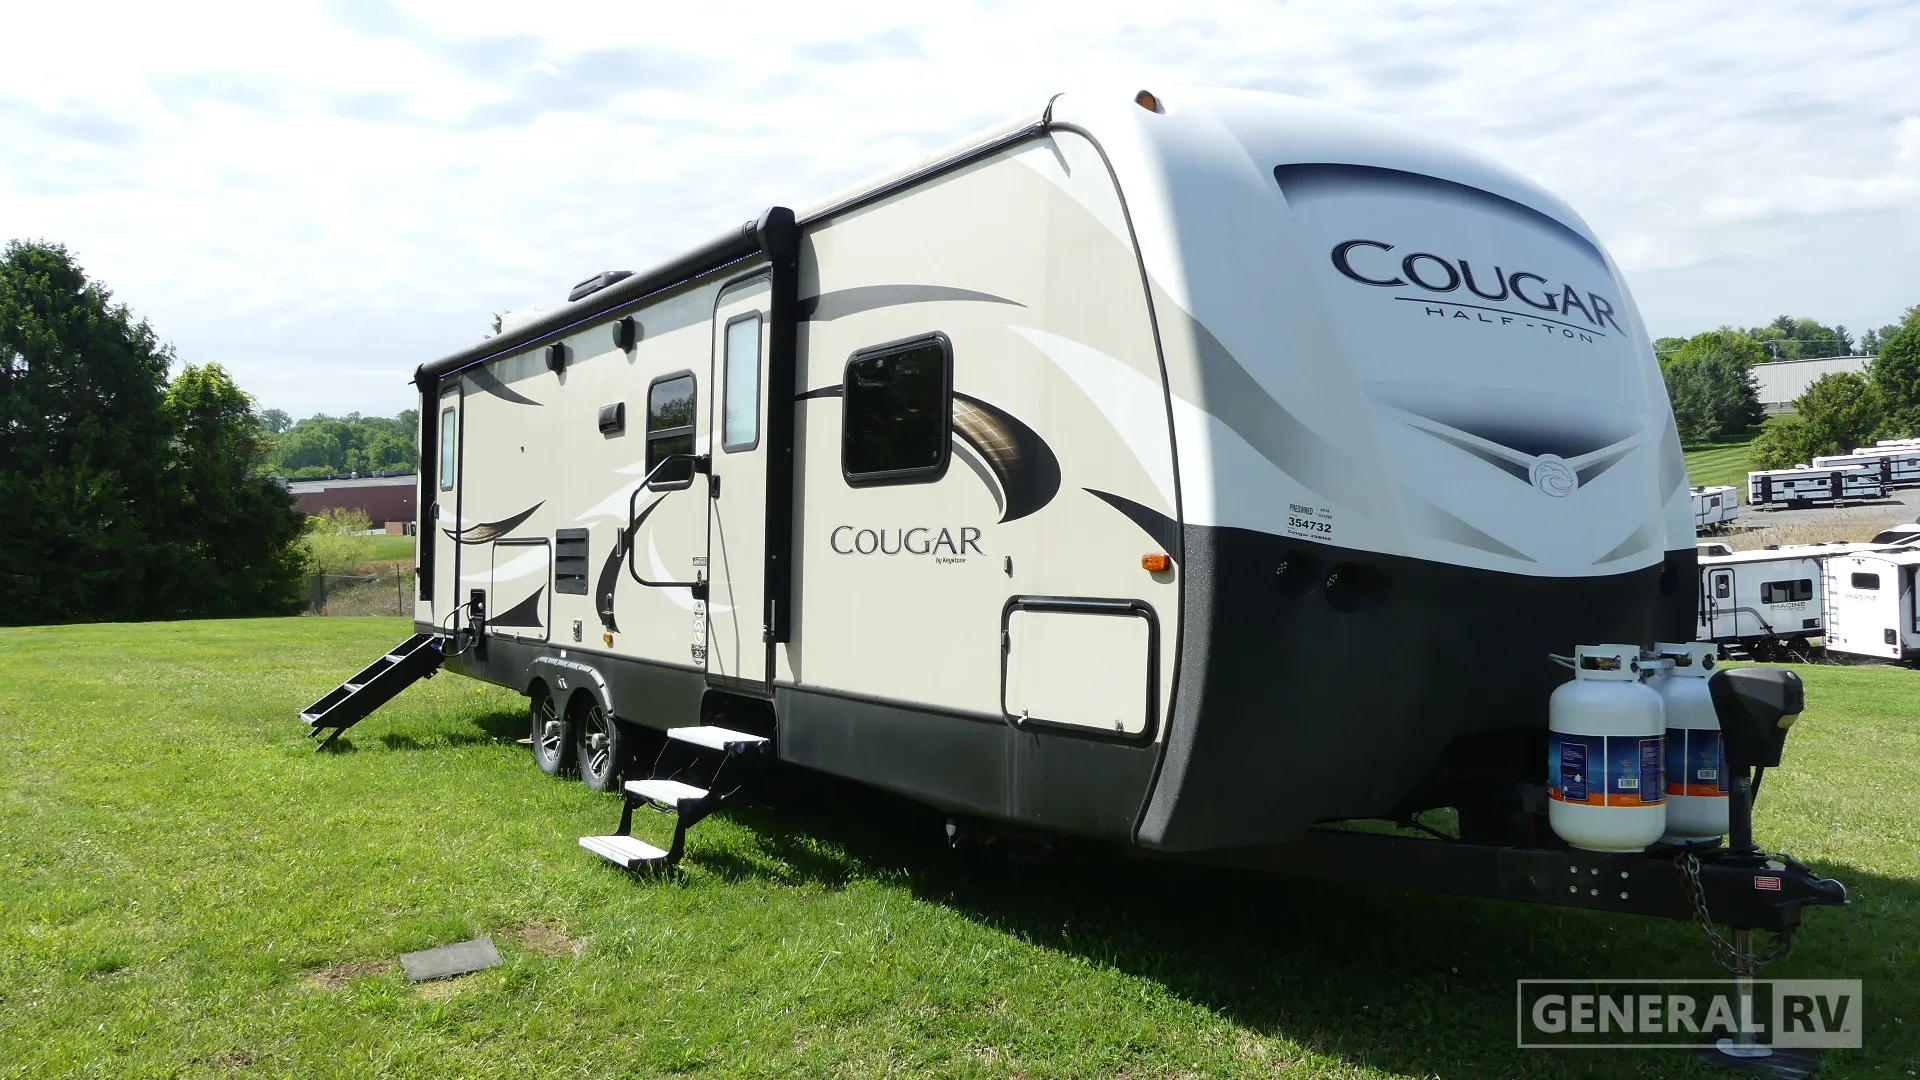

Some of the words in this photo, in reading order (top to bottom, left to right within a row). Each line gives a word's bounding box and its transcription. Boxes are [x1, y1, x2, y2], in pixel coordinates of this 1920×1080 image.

[1330, 238, 1628, 338] COUGAR
[1425, 306, 1594, 344] HALF-TON
[1288, 516, 1332, 533] 354732
[830, 525, 987, 556] COUGAR
[1770, 601, 1806, 610] IMAGINE
[1844, 593, 1877, 601] IMAGINE
